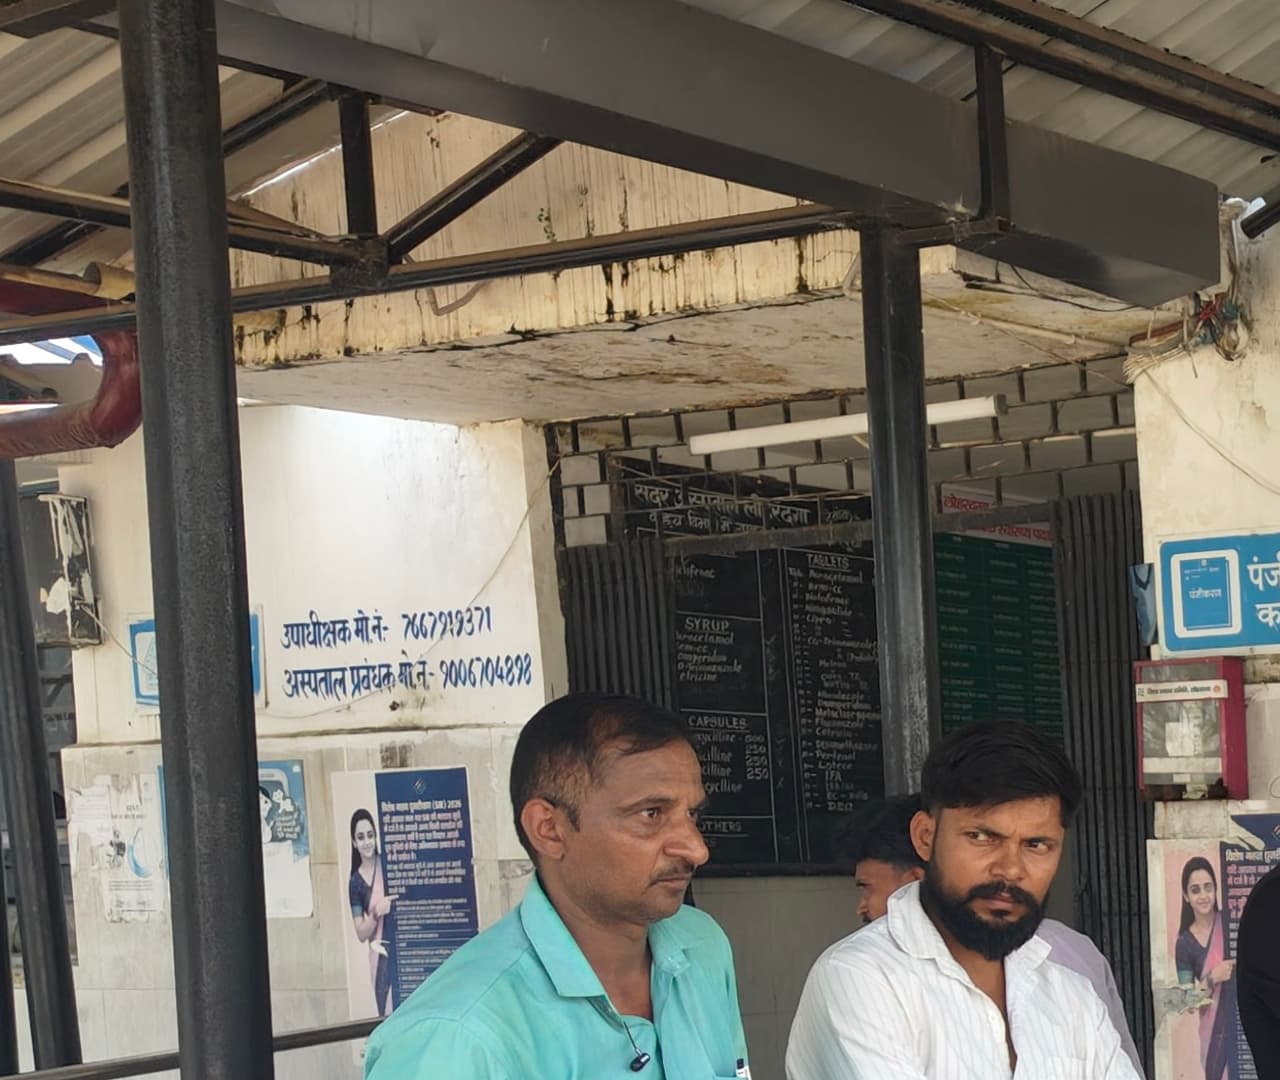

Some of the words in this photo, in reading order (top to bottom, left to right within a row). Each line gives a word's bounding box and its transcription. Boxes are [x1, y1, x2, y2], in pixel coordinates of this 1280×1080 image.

[281, 610, 353, 650] उपाधीक्षक
[685, 616, 730, 632] SYRUP
[283, 665, 349, 701] अस्पताल
[349, 657, 396, 698] प्रबंधक
[439, 652, 533, 690] 9006704898
[688, 714, 748, 730] CAPSULES
